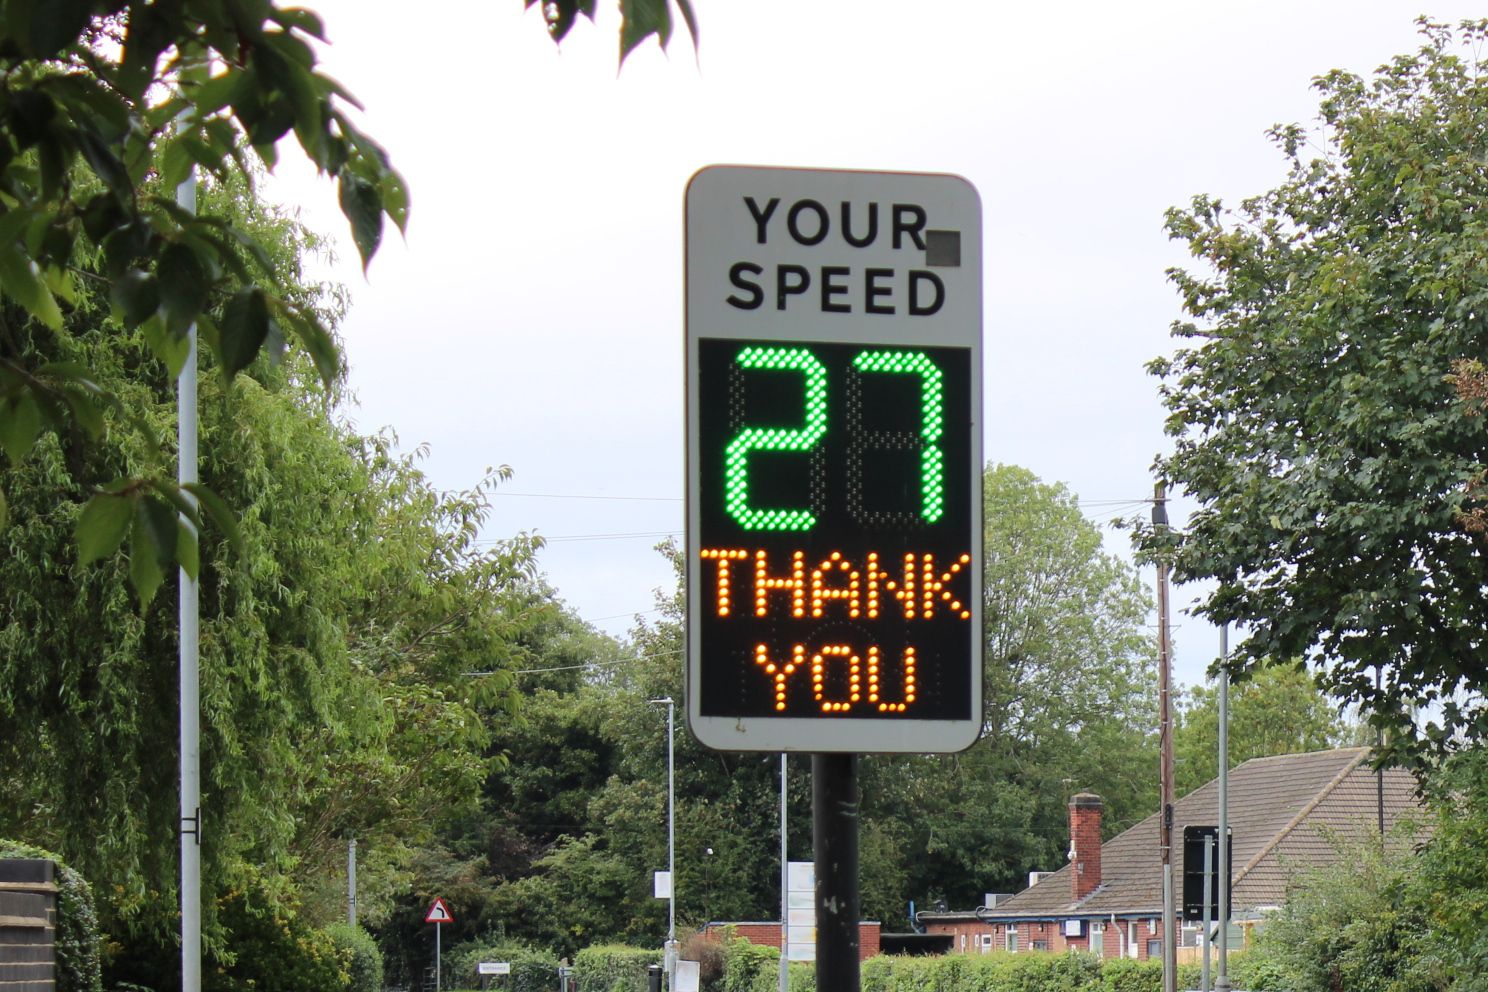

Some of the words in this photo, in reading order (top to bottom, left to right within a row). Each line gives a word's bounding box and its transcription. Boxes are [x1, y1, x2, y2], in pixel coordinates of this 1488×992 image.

[743, 196, 928, 251] YOUR
[726, 261, 946, 317] SPEED
[725, 347, 943, 531] 27
[700, 549, 972, 620] THANK
[755, 644, 916, 712] YOU
